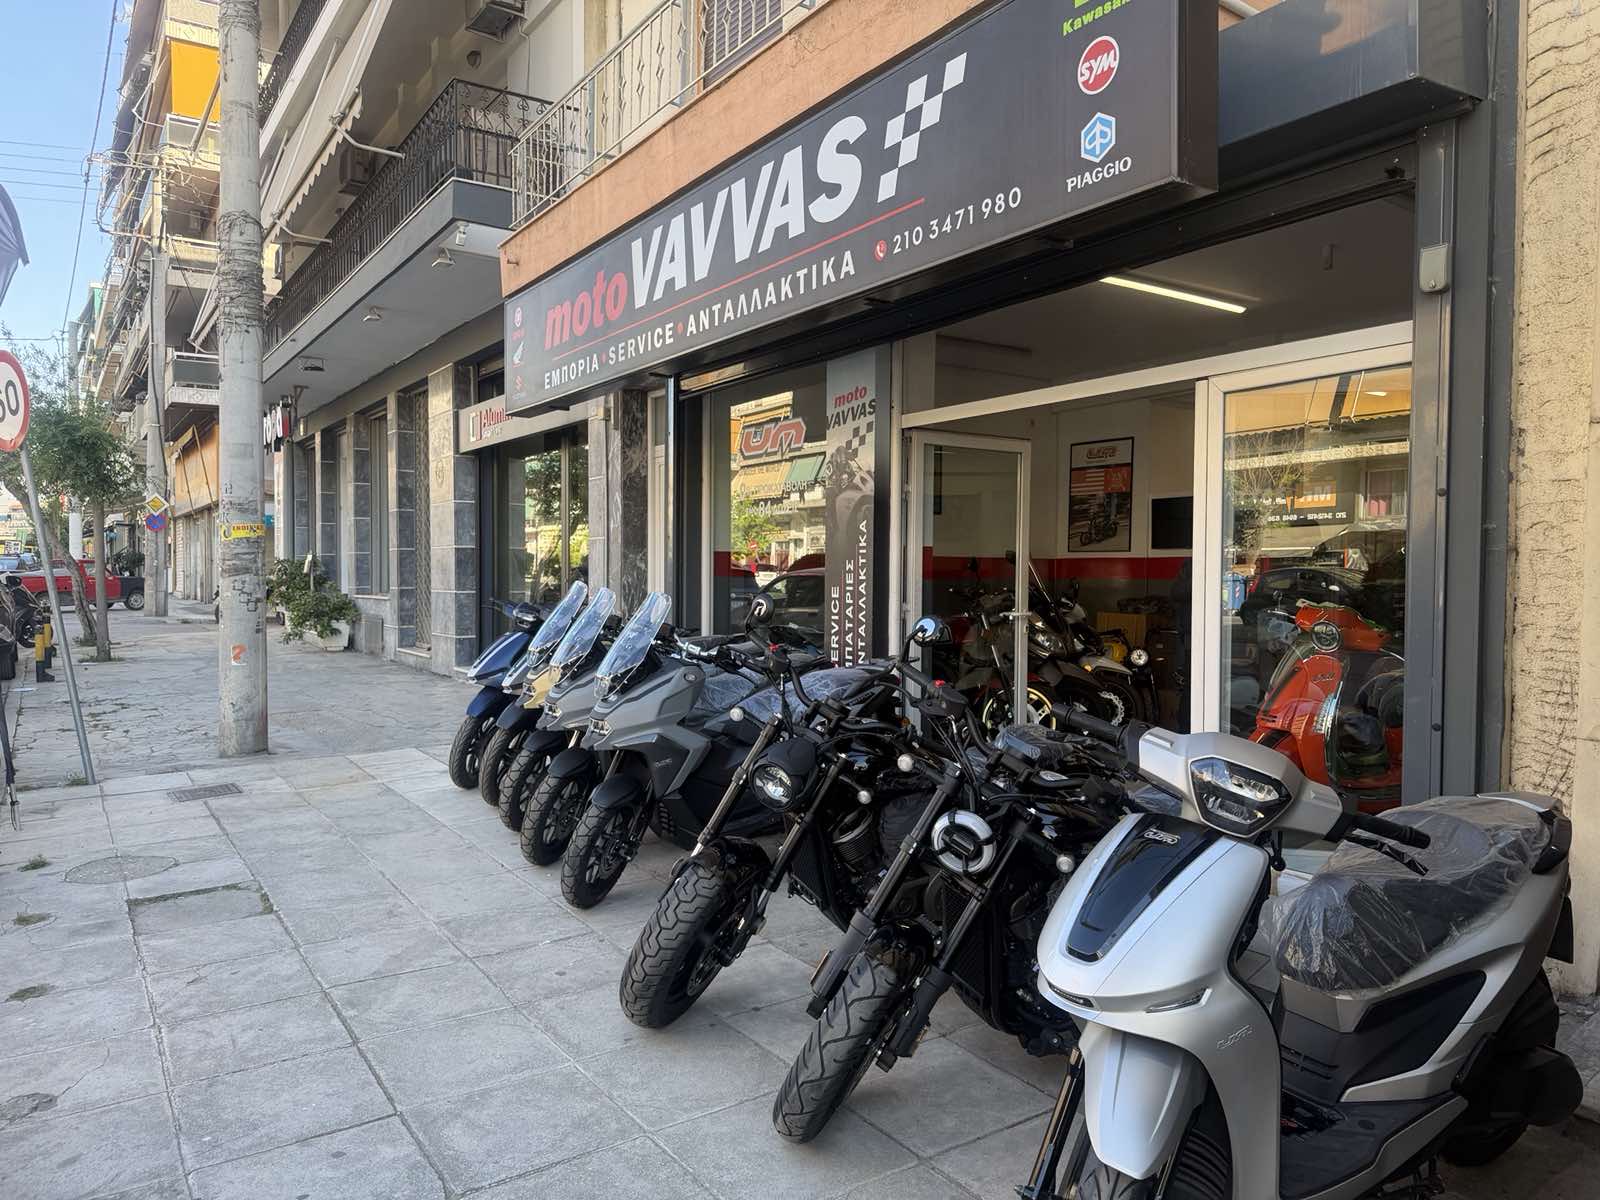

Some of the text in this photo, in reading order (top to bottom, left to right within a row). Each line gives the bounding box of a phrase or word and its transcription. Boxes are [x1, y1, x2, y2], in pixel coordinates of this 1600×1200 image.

[1081, 48, 1116, 84] SYM
[1066, 156, 1132, 192] PIAGGIO
[632, 115, 867, 309] VAVVAS
[893, 187, 1022, 255] 210 3471 980
[544, 250, 856, 390] ΕΜΠΟΡΙΑ SERVICE ΑΝΤΑΛΛΑΚΤΙΚΑ
[826, 398, 877, 431] VAVVAS
[833, 386, 868, 408] moto
[857, 519, 867, 664] ΝΤΑΛΛΑΚΤΙΚΑ
